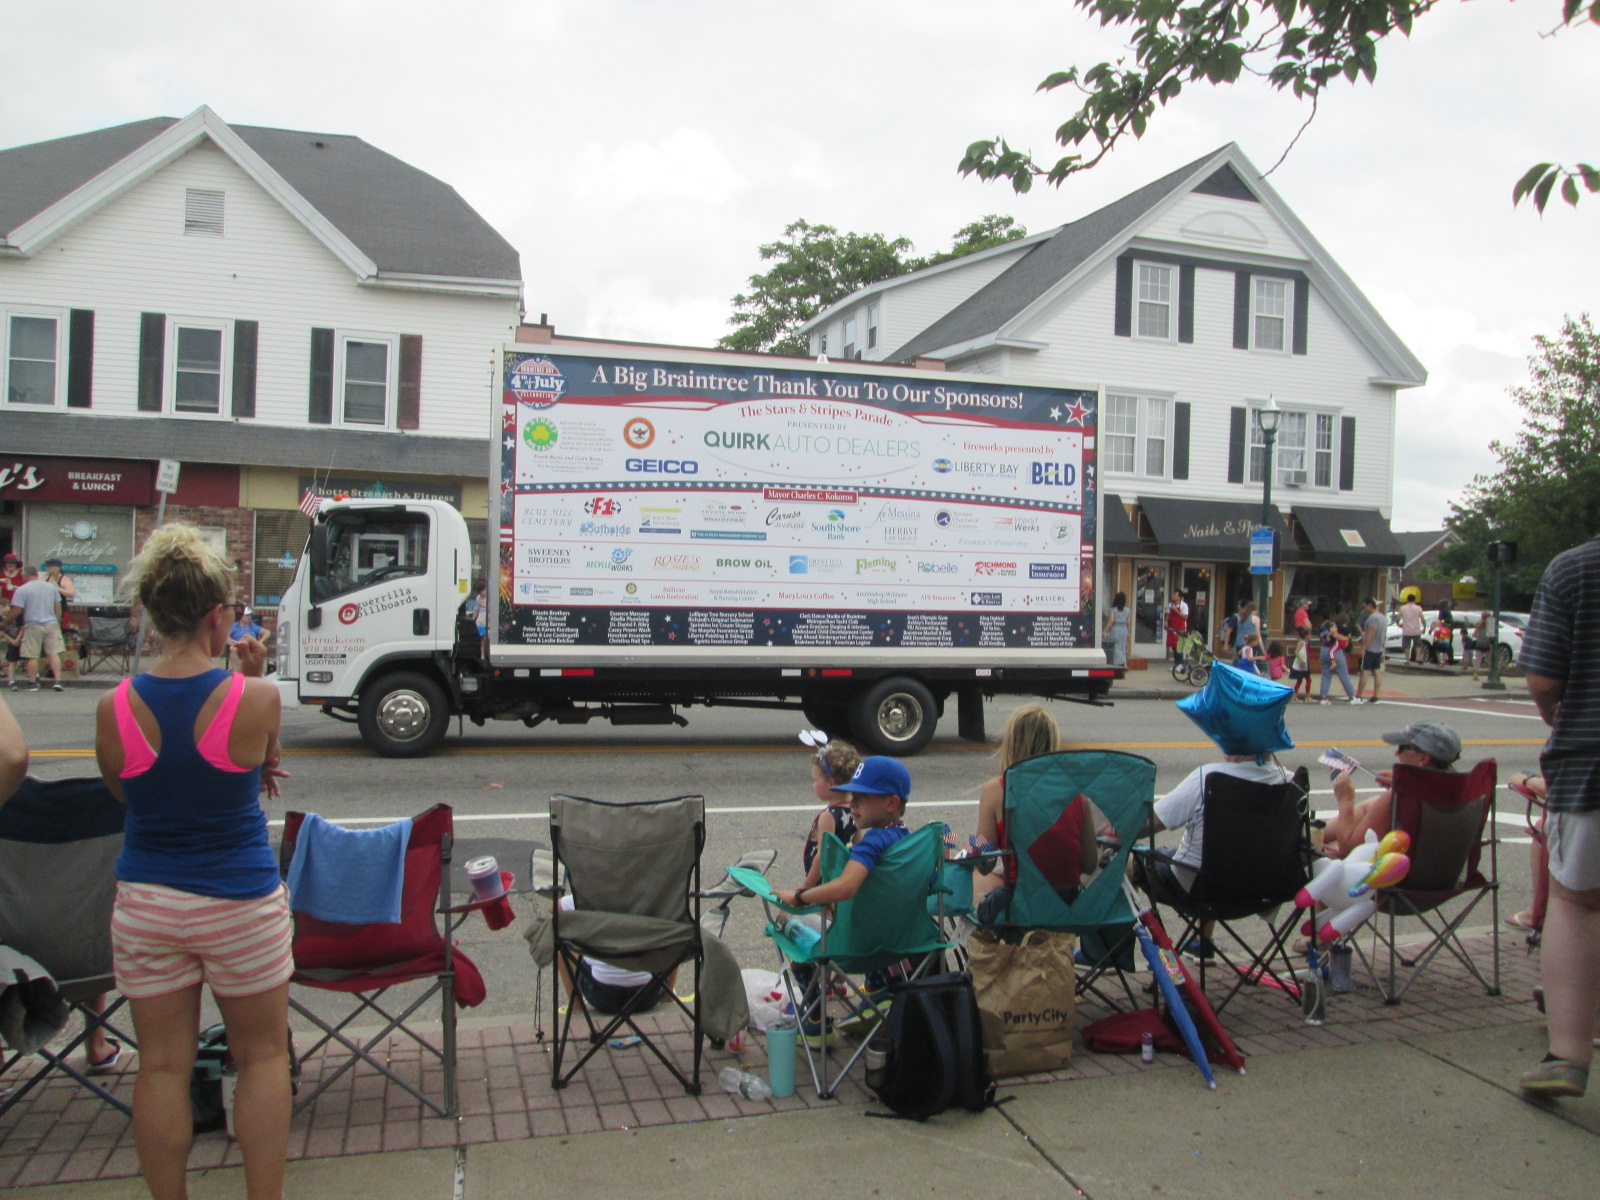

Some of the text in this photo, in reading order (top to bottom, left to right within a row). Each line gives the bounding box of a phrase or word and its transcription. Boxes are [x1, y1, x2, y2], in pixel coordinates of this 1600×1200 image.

[534, 375, 564, 392] July
[592, 365, 1023, 411] A Big Braintree Thank You To Our Sponsors!
[738, 404, 893, 426] The Stars & Stripes Parade
[530, 417, 558, 433] STREET
[787, 421, 834, 430] PRESENTED
[526, 439, 557, 452] METALS
[703, 430, 921, 459] QUIRK AUTO DEALERS
[963, 441, 1055, 456] Fireworks presented by
[625, 458, 698, 474] GEICO
[954, 462, 996, 473] LIBERTY
[999, 463, 1020, 475] BAY
[68, 472, 122, 482] BREAKFAST
[1032, 462, 1076, 487] BELD
[72, 482, 114, 491] & LUNCH
[305, 487, 349, 498] Shotte
[351, 488, 402, 500] Strength
[414, 493, 454, 503] Fitness
[768, 490, 853, 502] Mayor Charles C. Kokoros
[592, 497, 614, 516] F1
[766, 507, 801, 526] Caruso
[888, 508, 920, 519] Messina
[522, 518, 573, 526] CEMETERY
[1014, 516, 1038, 525] Import
[580, 521, 631, 536] Southside
[812, 523, 860, 533] South Shore
[884, 526, 918, 536] HERBST
[1014, 524, 1040, 532] Werks
[1184, 522, 1220, 538] Nails
[1224, 521, 1236, 535] &
[827, 533, 845, 541] Bank
[46, 542, 117, 562] Ashley's
[528, 548, 571, 556] SWEENEY
[528, 556, 571, 564] BROTHERS
[586, 560, 612, 569] RECYCLE
[716, 558, 751, 568] BROW
[855, 557, 897, 575] Fleming
[611, 564, 633, 572] WORKS
[918, 561, 958, 575] Robelle
[975, 561, 1017, 576] RICHMOND
[1031, 570, 1065, 579] Insurance
[356, 588, 412, 611] guerrilla
[778, 592, 813, 601] MaryLou's
[357, 594, 418, 618] billboards
[852, 762, 864, 780] B
